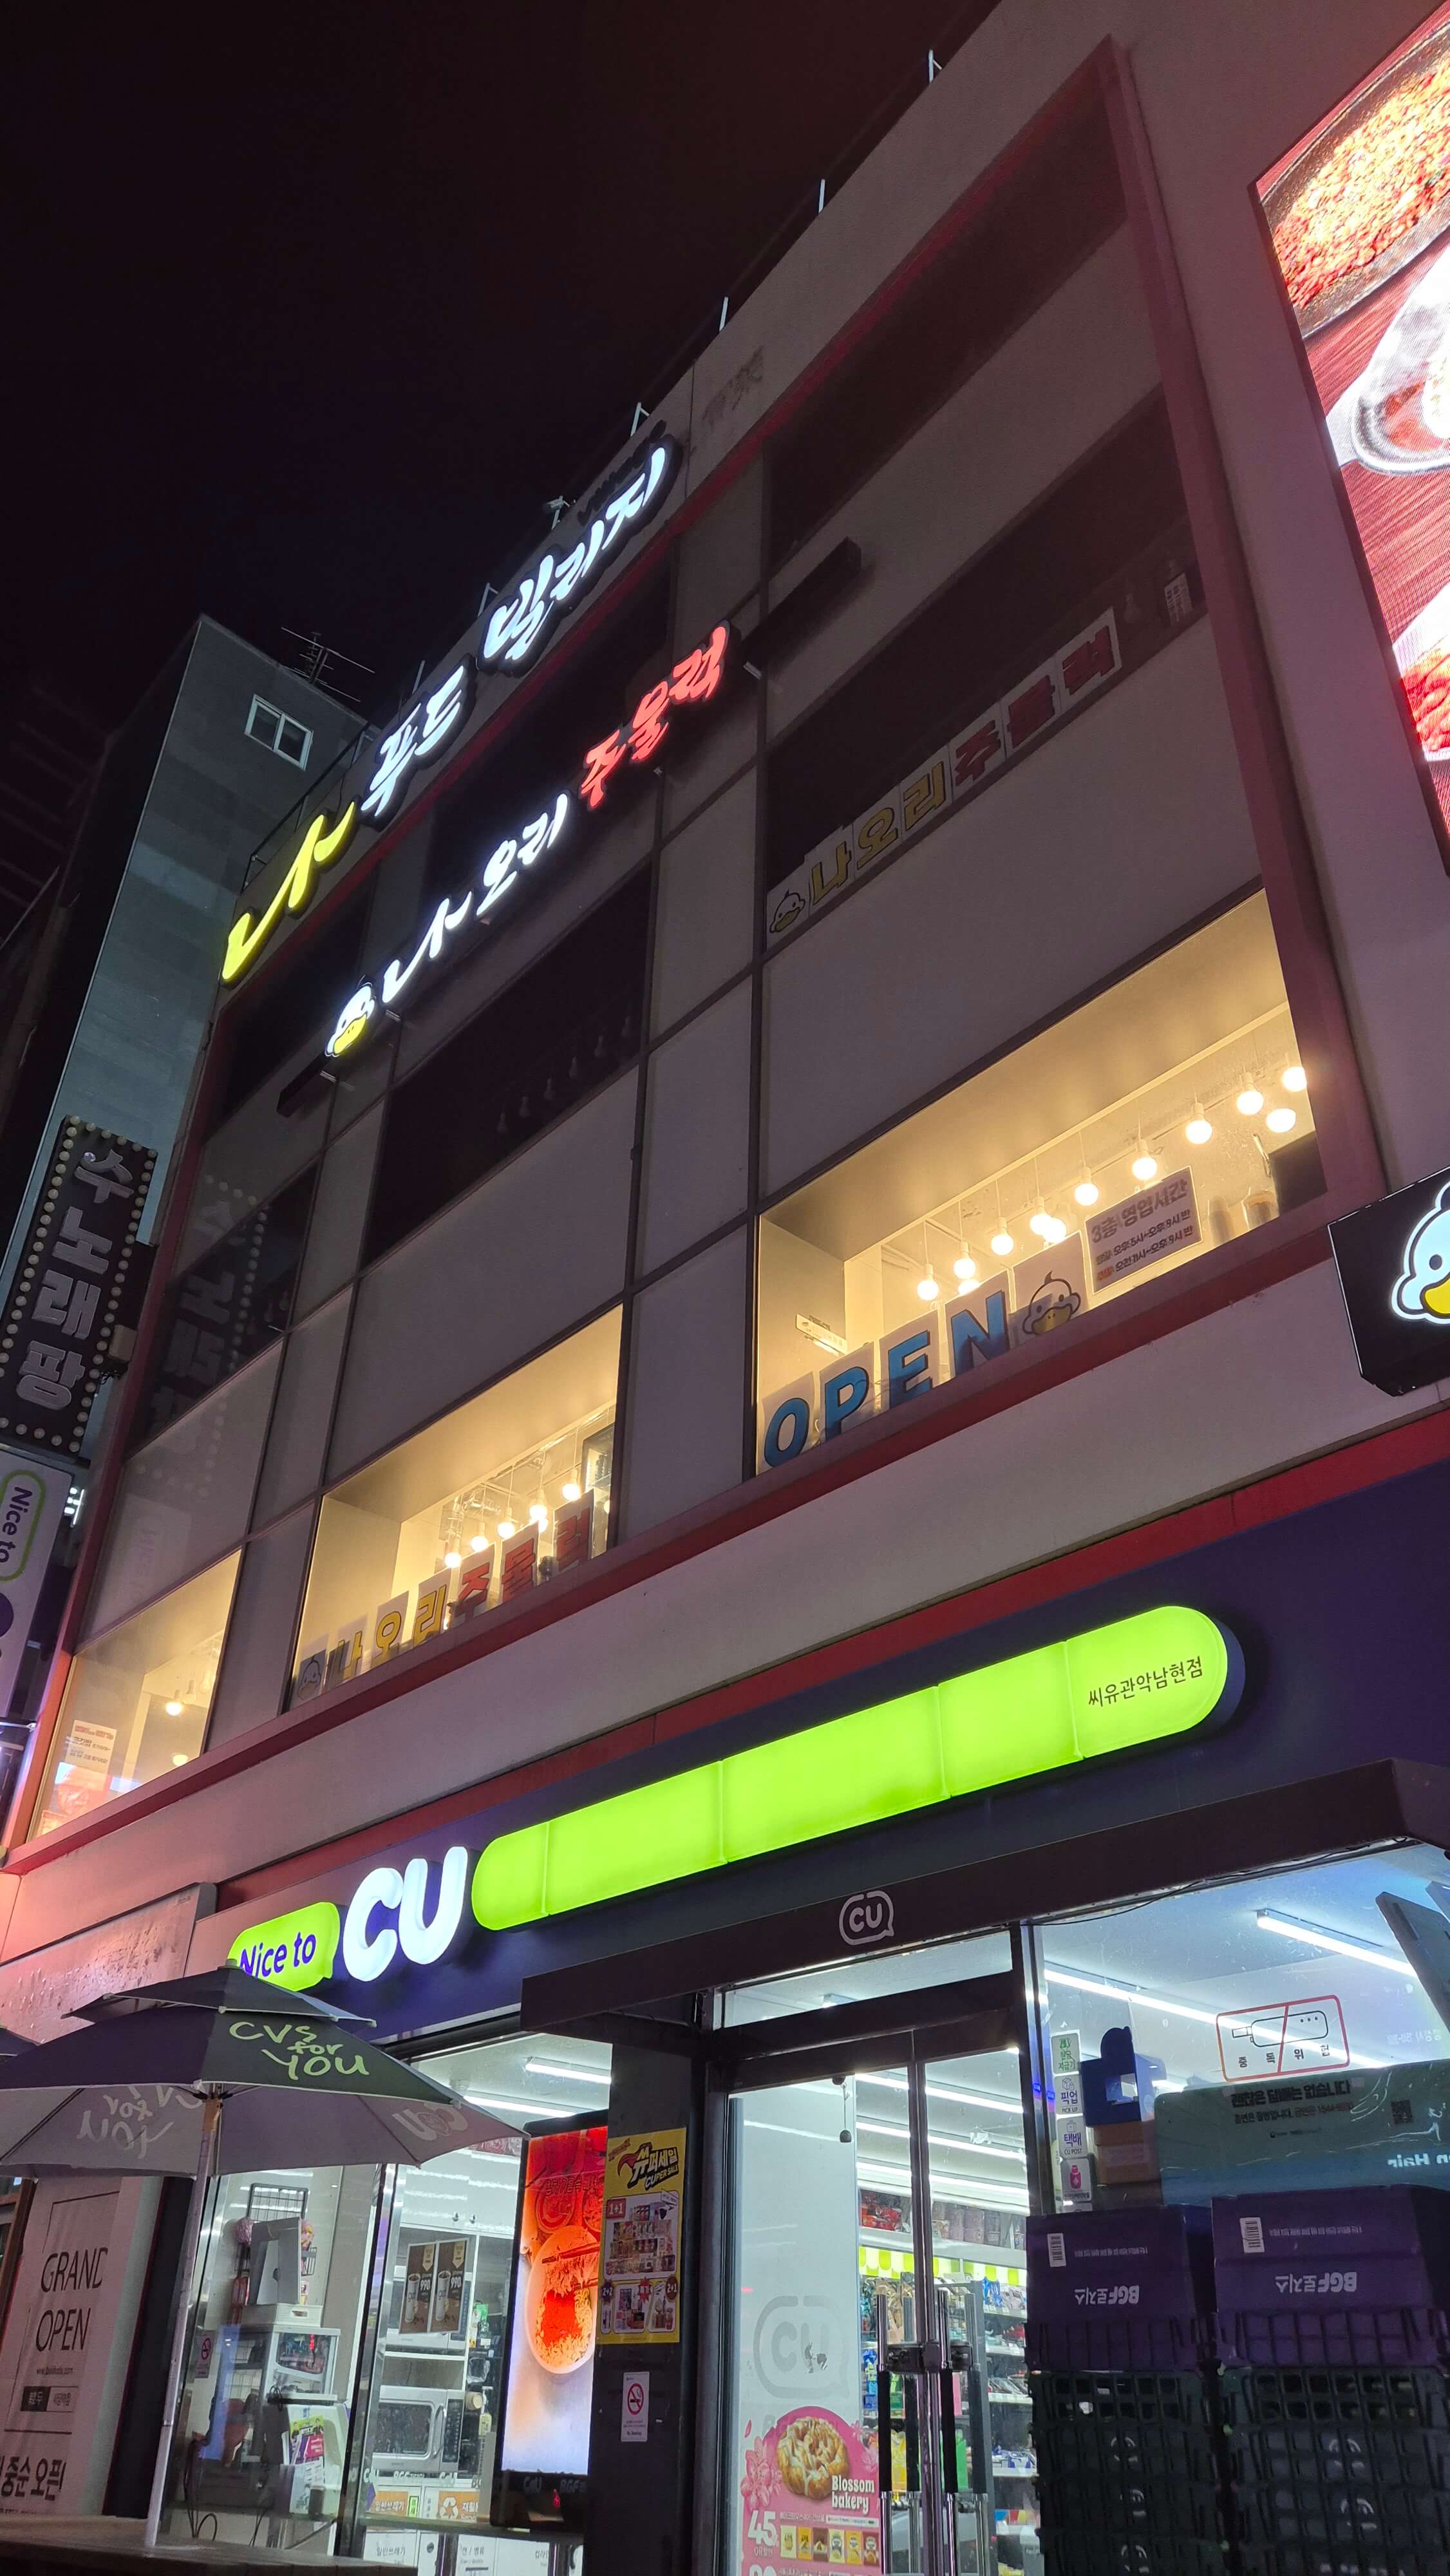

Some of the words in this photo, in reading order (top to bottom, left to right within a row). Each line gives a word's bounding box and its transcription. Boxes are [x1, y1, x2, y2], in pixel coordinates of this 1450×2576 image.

[1091, 1215, 1118, 1243] 3층
[1122, 1179, 1187, 1227] 영업시간
[764, 1289, 1012, 1469] OPEN
[2, 1486, 33, 1536] Nice
[0, 1540, 16, 1563] to
[1088, 1655, 1203, 1707] 씨유관악남현점
[240, 1941, 288, 1979] Nice
[292, 1931, 316, 1969] to
[343, 1846, 469, 1982] CU
[849, 1902, 883, 1933] CU
[228, 2020, 317, 2045] CVS
[290, 2040, 344, 2056] for
[261, 2047, 370, 2081] YOU
[1060, 2090, 1078, 2105] 픽업
[1304, 2079, 1351, 2099] 없습니다
[1064, 2132, 1082, 2146] 택배
[609, 2202, 623, 2215] 1+1
[41, 2246, 108, 2293] GRAND
[1274, 2271, 1358, 2293] BGF로지스
[1073, 2284, 1140, 2306] BGF로지스
[35, 2307, 91, 2351] OPEN
[30, 2458, 66, 2501] 오픈
[831, 2474, 876, 2494] Blossom
[831, 2490, 869, 2515] bakery
